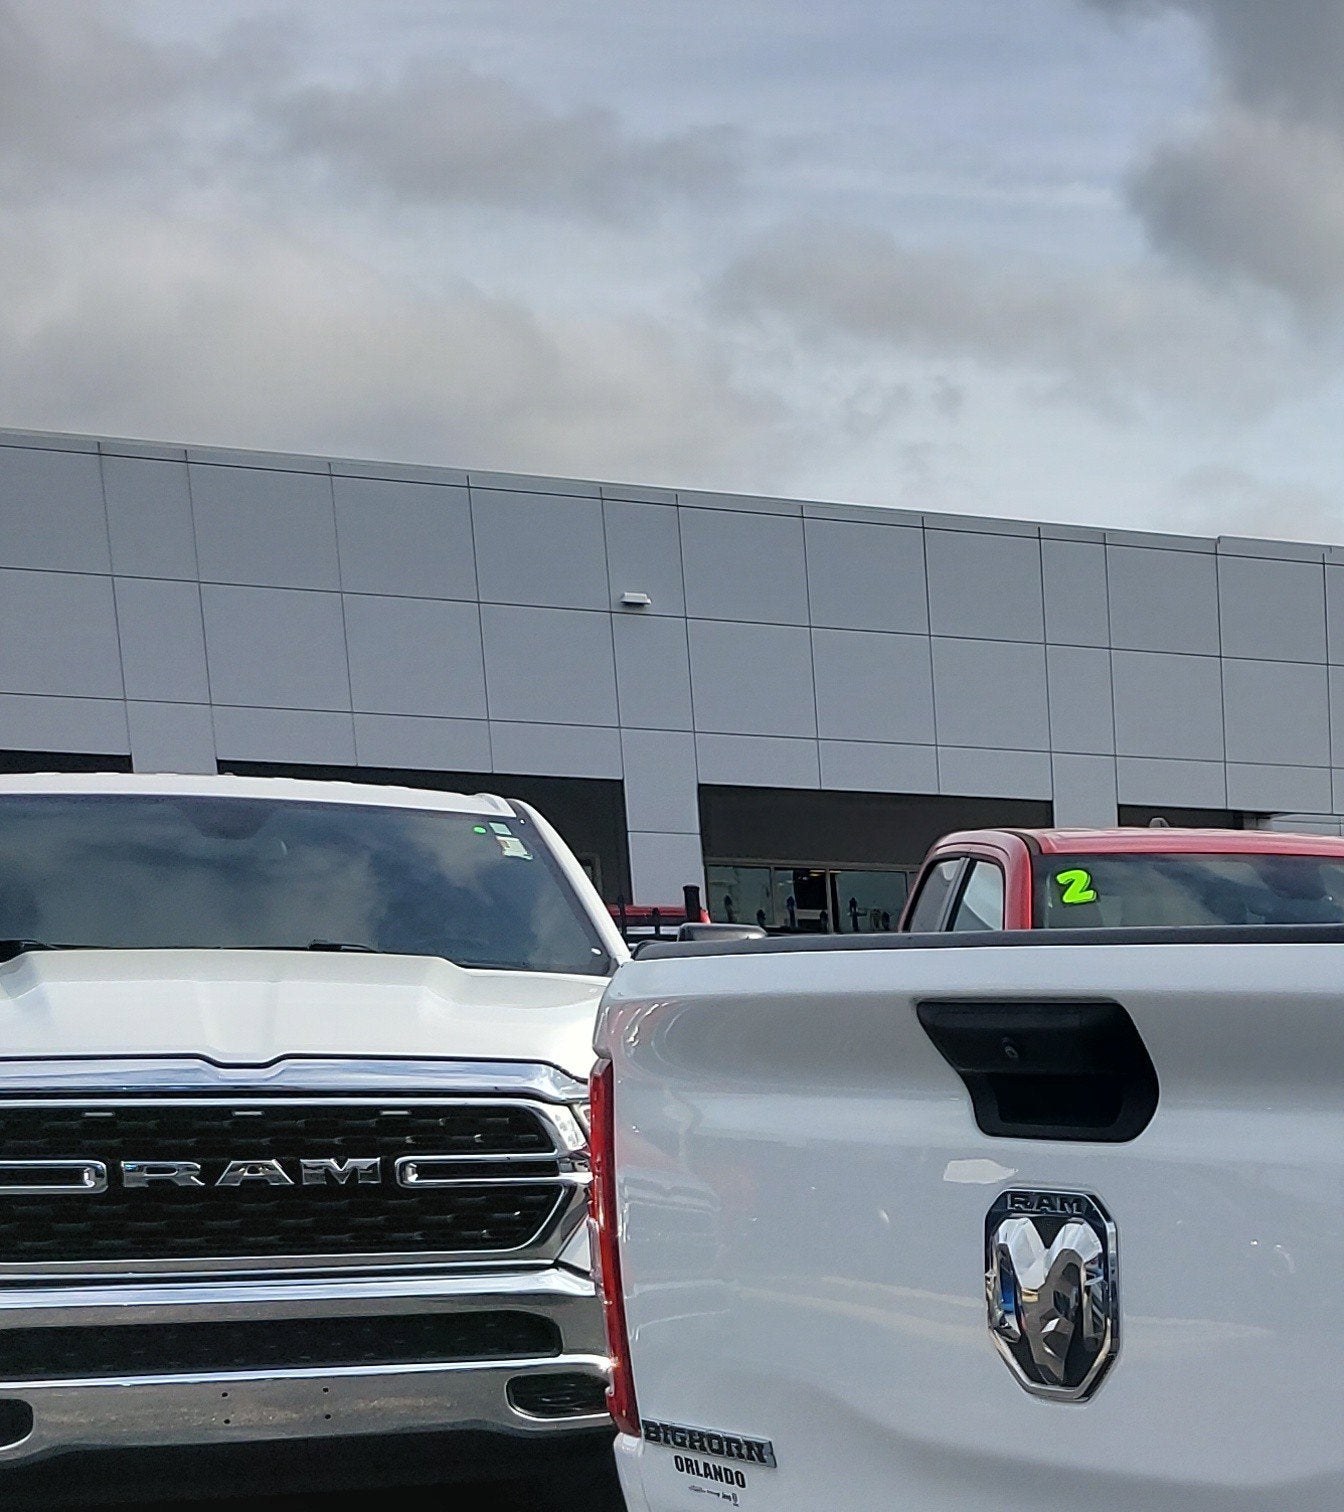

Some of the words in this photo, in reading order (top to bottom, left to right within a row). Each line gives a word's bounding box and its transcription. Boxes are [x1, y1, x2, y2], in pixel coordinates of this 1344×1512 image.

[1056, 869, 1097, 904] 2
[121, 1157, 382, 1188] RAM
[1006, 1193, 1084, 1213] RAM
[674, 1455, 746, 1489] ORLANDO
